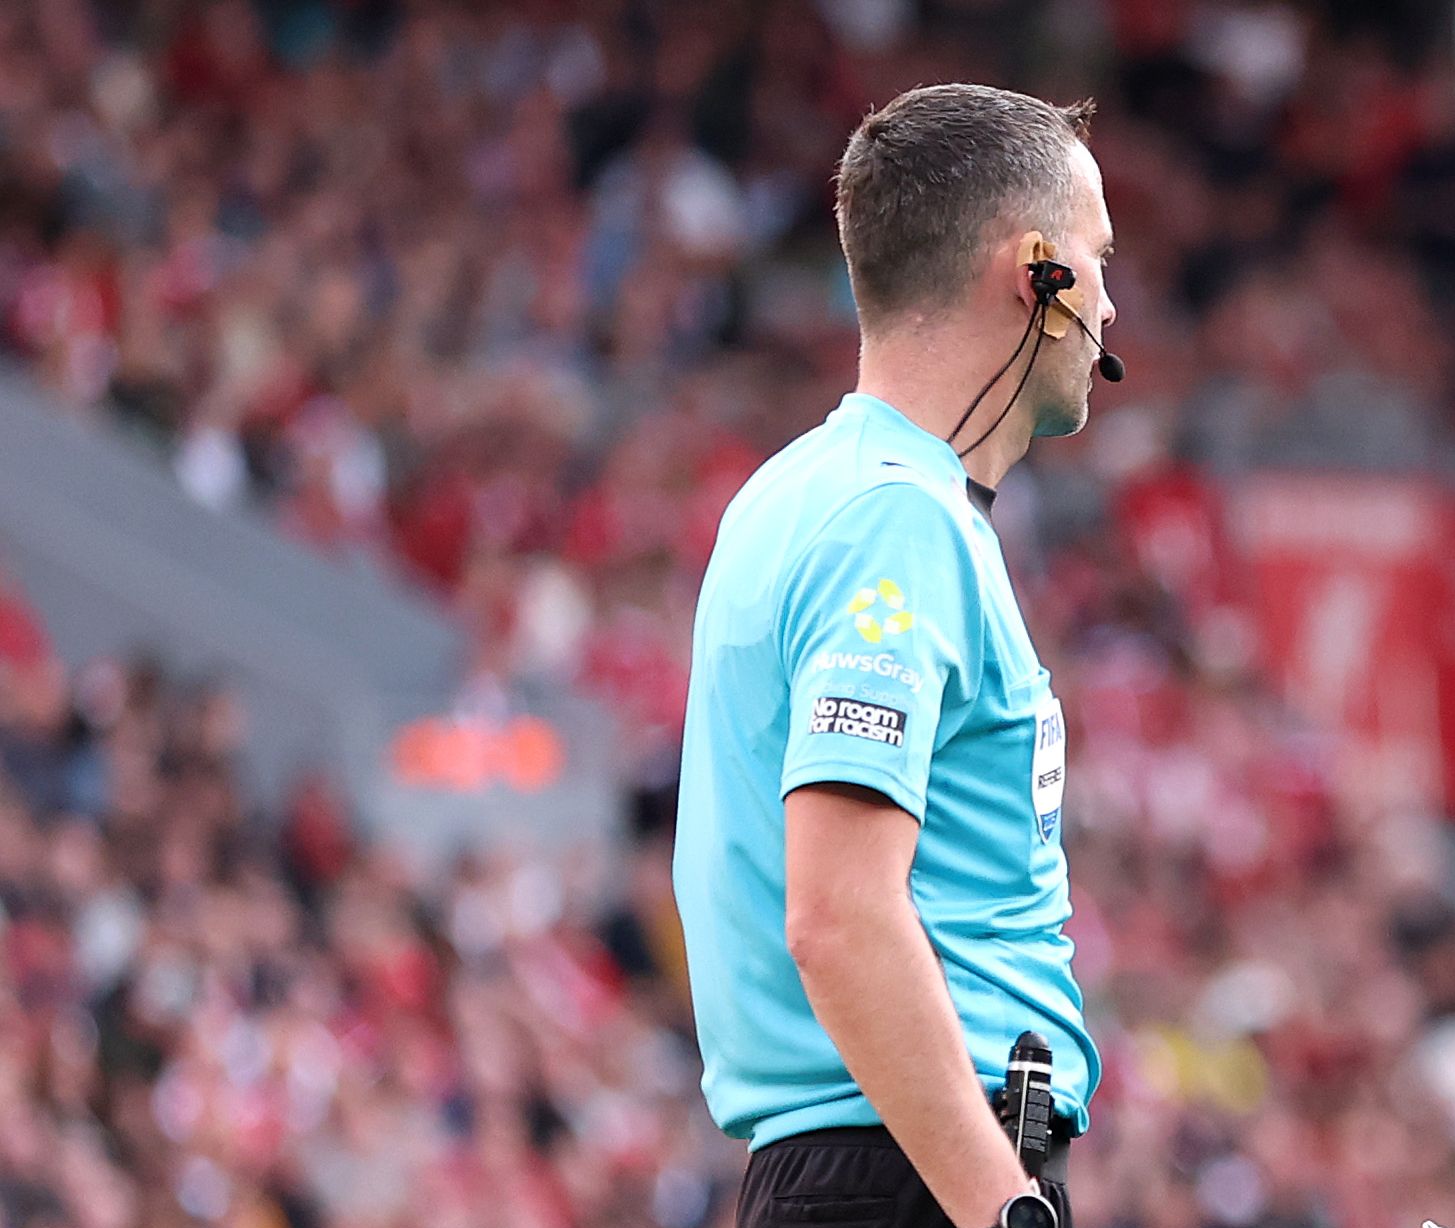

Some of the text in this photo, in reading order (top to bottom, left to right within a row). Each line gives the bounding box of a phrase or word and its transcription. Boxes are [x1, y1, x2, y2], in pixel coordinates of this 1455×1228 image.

[813, 697, 899, 729] No room
[834, 716, 904, 748] racism
